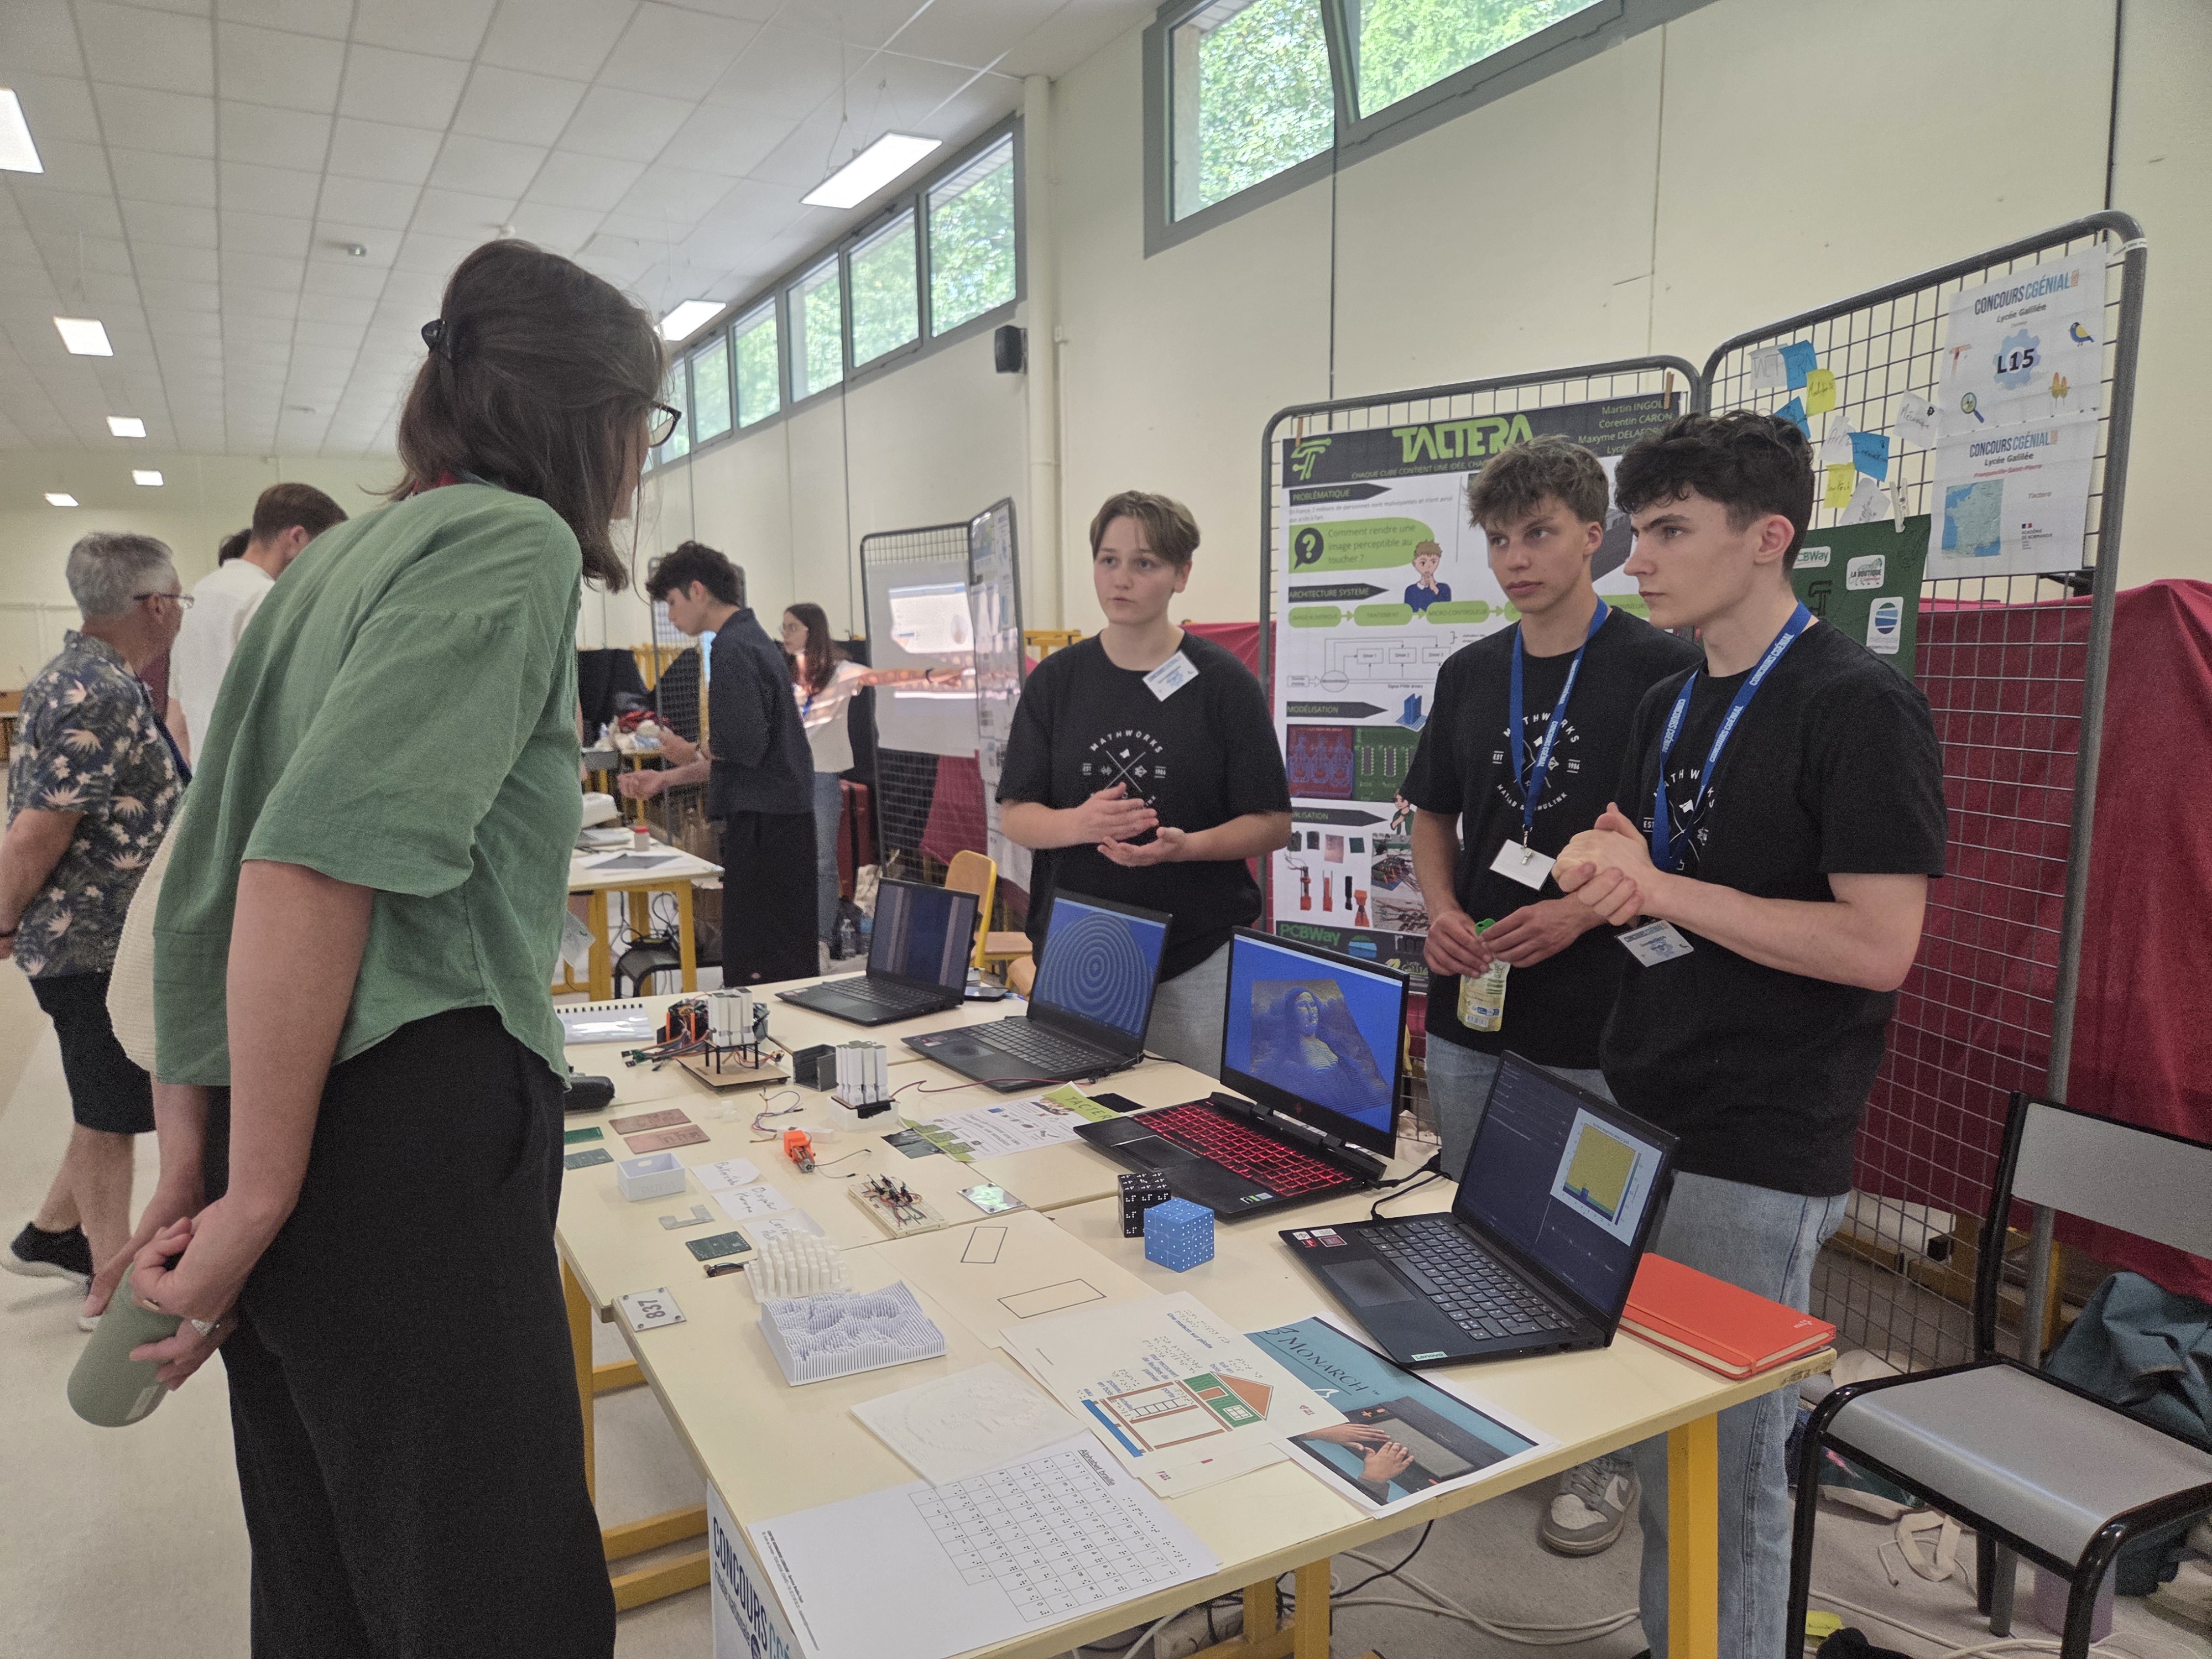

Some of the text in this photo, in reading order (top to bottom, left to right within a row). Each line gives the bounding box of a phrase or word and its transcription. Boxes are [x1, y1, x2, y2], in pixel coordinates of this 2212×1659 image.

[1975, 272, 2070, 315] CONCOURS CGÉNIAL
[1997, 304, 2047, 323] Lycée Galilée
[1997, 348, 2035, 374] L15
[1601, 400, 1663, 415] Martin INGOL
[1598, 413, 1673, 429] Corentin CARON
[1392, 414, 1532, 463] TACTERA
[1578, 433, 1615, 445] Maxyme
[1969, 431, 2050, 458] CONCOURS CGÉNIAL
[1607, 445, 1629, 455] Lycé
[1984, 452, 2033, 467] Lycée Galilée
[1292, 489, 1351, 502] PROBLÉMATIQUE
[1328, 525, 1416, 538] Comment rendre une
[1329, 537, 1412, 554] image perceptible au
[1328, 554, 1364, 564] toucher ?
[1797, 550, 1829, 562] CBWay
[1858, 570, 1881, 578] BOUTIQUE
[1289, 587, 1369, 599] ARCHITECTURE SYSTÈME
[1750, 633, 1795, 686] CONCOURS CGÉNIAL
[1288, 705, 1338, 714] MODÉLISATION
[1503, 713, 1580, 743] MTHWRKS
[1709, 705, 1744, 763] CONCOURS CGÉNIAL
[1091, 729, 1163, 753] MATHWORKS
[1496, 784, 1517, 807] MATLAB
[1533, 792, 1568, 811] IMULINK
[1280, 923, 1340, 946] PCBWay
[637, 1300, 666, 1319] 837
[1278, 1337, 1370, 1392] MONARCH
[1079, 1449, 1116, 1486] Alphabet braille
[713, 1516, 767, 1651] CONCOURS
